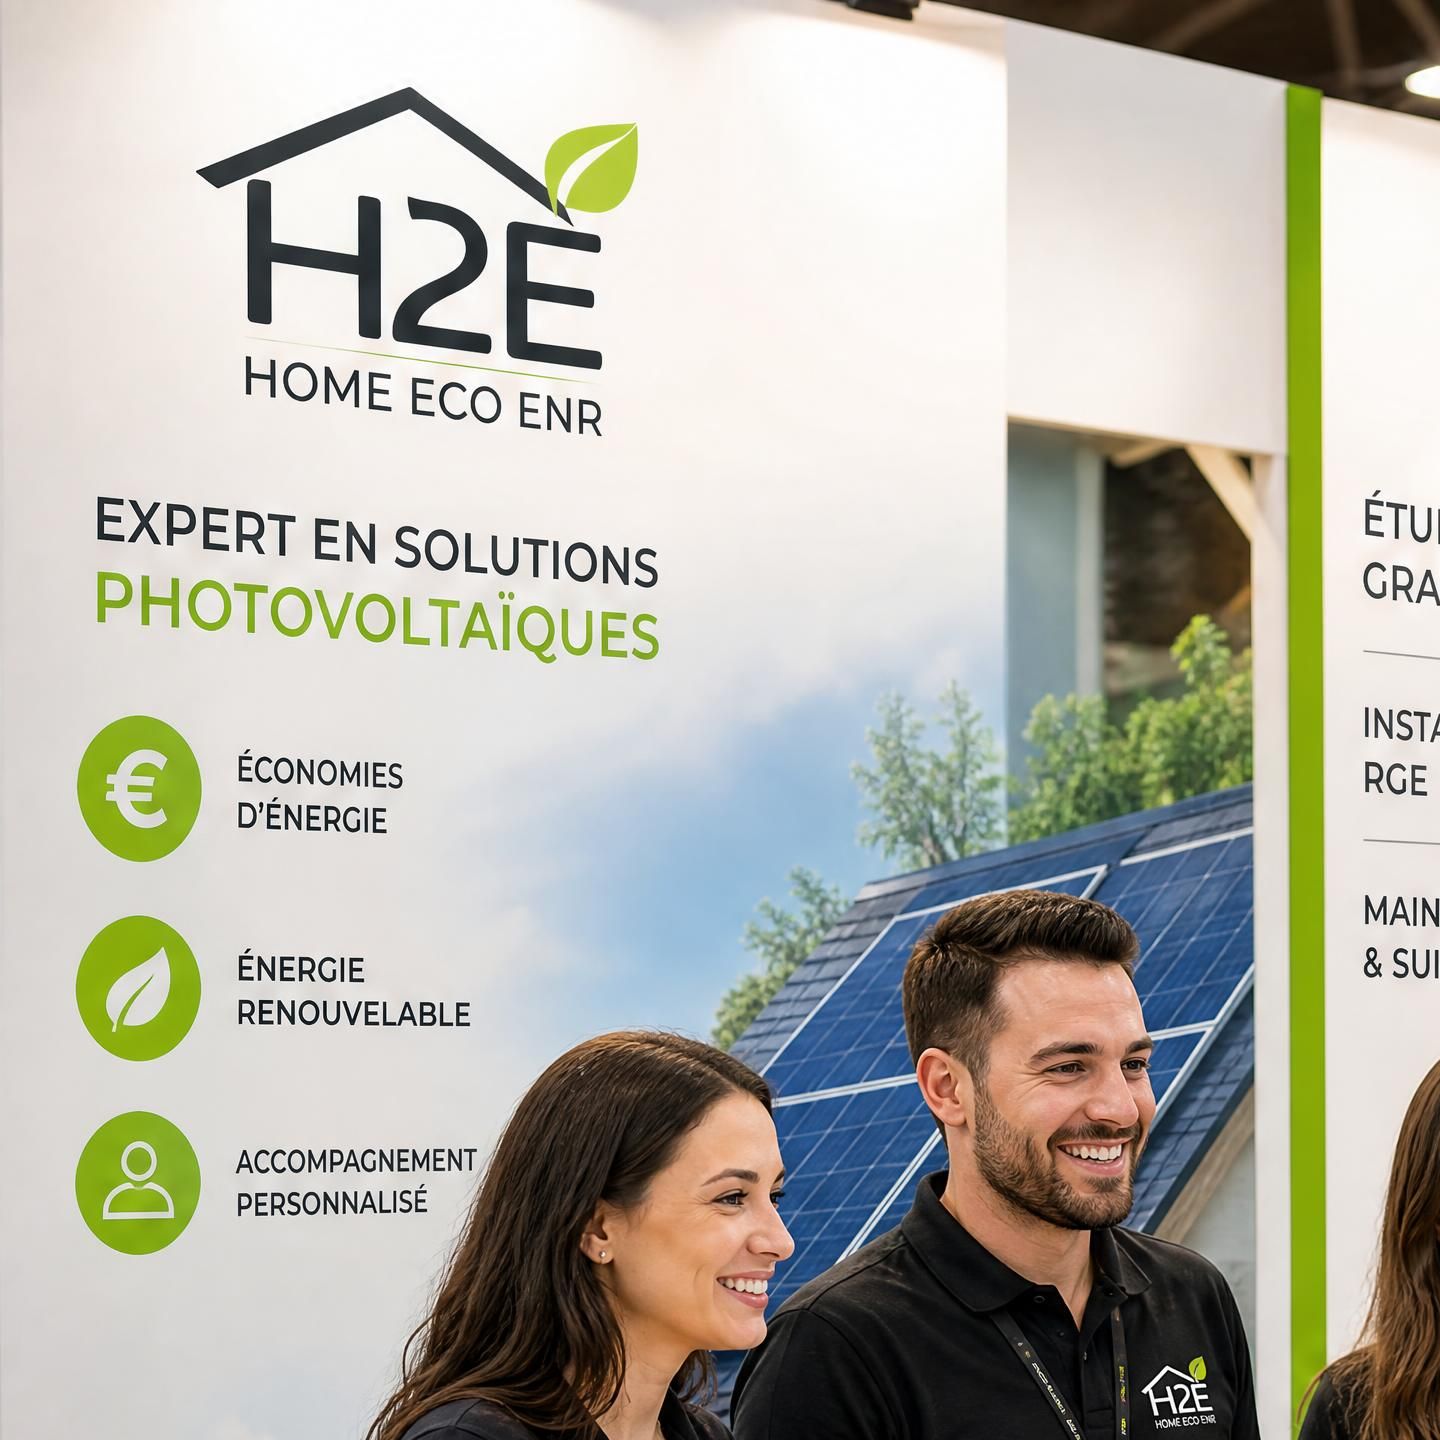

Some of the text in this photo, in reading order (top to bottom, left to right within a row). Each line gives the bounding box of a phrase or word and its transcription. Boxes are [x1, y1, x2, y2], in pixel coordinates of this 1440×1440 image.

[246, 178, 603, 371] H2E
[244, 355, 603, 437] HOME ECO ENR
[96, 495, 659, 589] EXPERT EN SOLUTIONS
[95, 570, 660, 665] PHOTOVOLTAÏQUES
[237, 748, 404, 790] ÉCONOMIES
[1364, 761, 1428, 797] RGE
[237, 796, 388, 834] D'ÉNERGIE
[237, 948, 365, 983] ÉNERGIE
[1363, 946, 1383, 979] &
[237, 999, 471, 1027] RENOUVELABLE
[235, 1147, 478, 1175] ACCOMPAGNEMENT
[237, 1183, 429, 1217] PERSONNALISÉ
[1148, 1383, 1213, 1416] H2E
[1154, 1417, 1181, 1430] HOME
[1182, 1415, 1200, 1427] ECO
